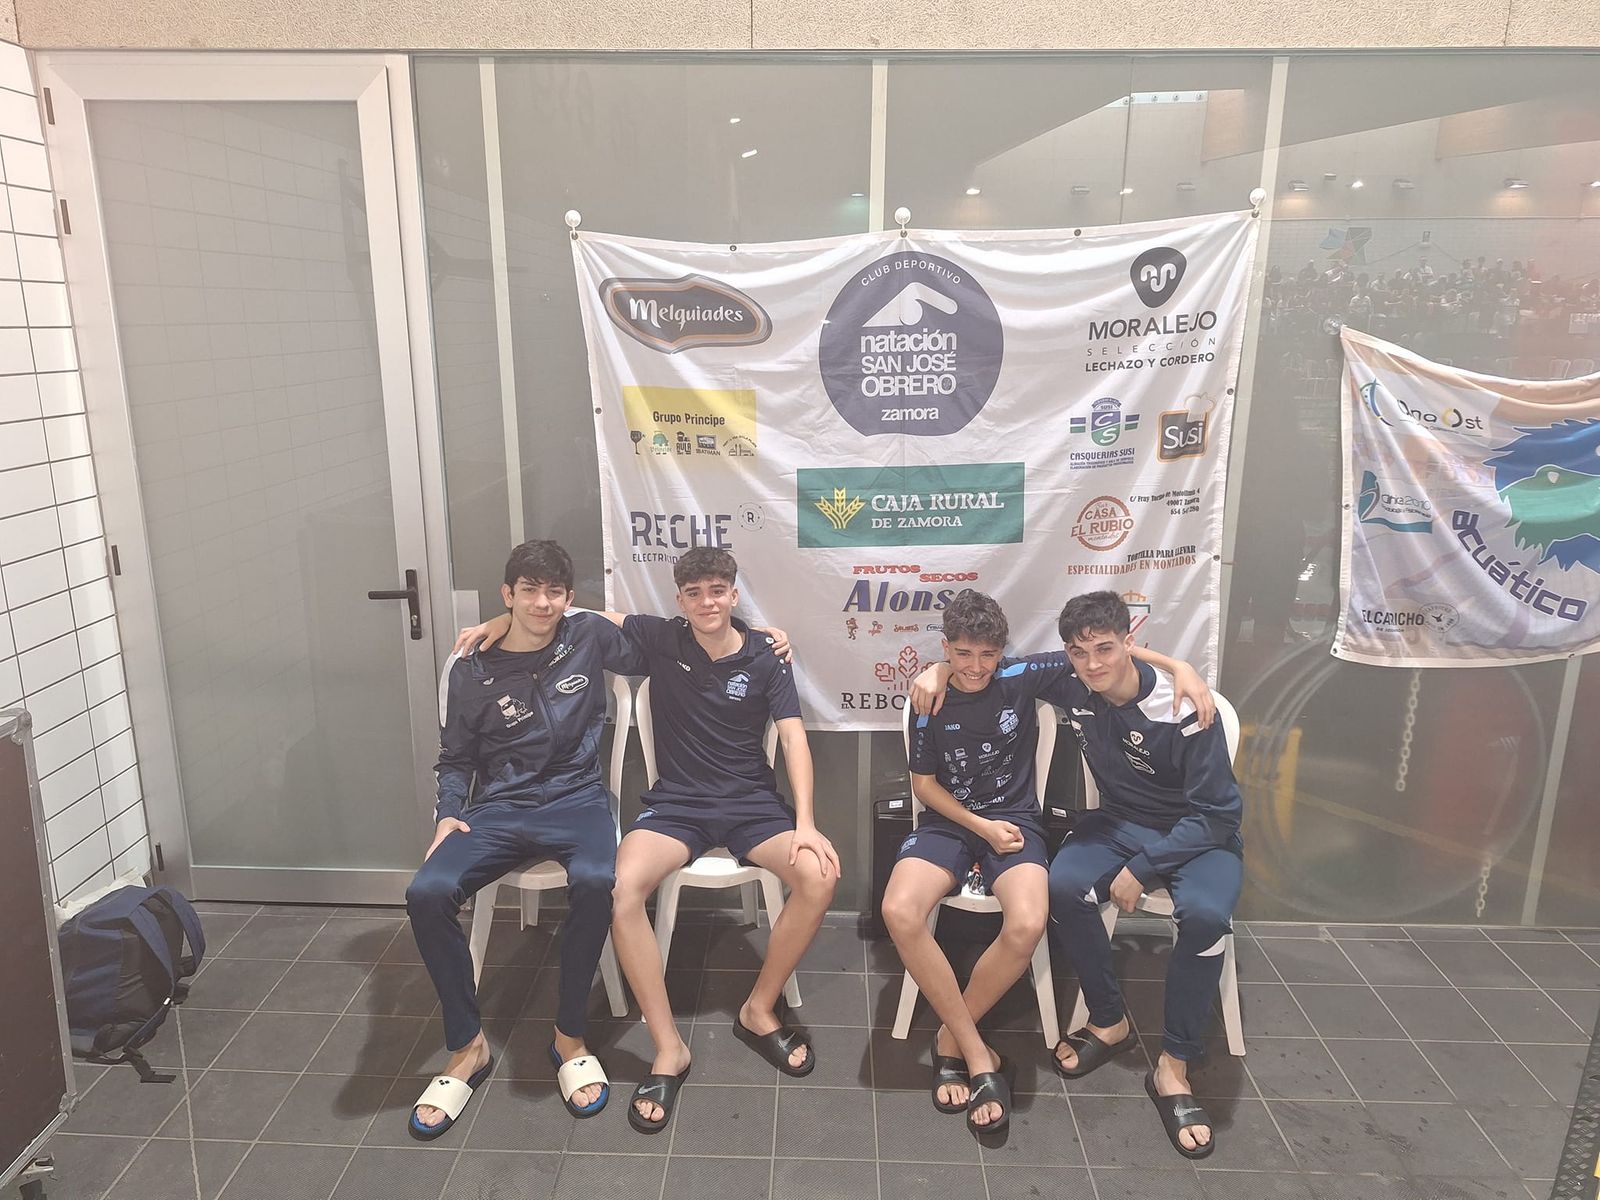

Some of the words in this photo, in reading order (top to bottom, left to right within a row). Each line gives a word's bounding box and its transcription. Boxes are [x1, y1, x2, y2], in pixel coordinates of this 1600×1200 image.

[861, 264, 891, 286] CLUB
[895, 259, 961, 284] DEPORTIVO
[629, 297, 744, 331] Melquiades
[1088, 310, 1217, 341] MORALEJO
[861, 328, 957, 353] natación
[861, 355, 901, 375] SAN
[906, 351, 957, 373] JOSÉ
[1085, 359, 1143, 372] LECHAZO
[1148, 358, 1156, 368] Y
[1160, 352, 1215, 367] CORDERO
[861, 374, 957, 397] OBRERO
[653, 411, 681, 424] Grupo
[881, 407, 939, 421] zamora
[1163, 423, 1203, 449] Susi
[1119, 448, 1135, 457] SUSI
[871, 495, 925, 512] CAJA
[929, 491, 1004, 511] RURAL
[871, 518, 892, 529] DE
[898, 516, 963, 528] ZAMORA
[1085, 507, 1116, 520] CASA
[630, 511, 732, 549] RECHE
[1071, 525, 1086, 537] EL
[1090, 518, 1134, 533] RUBIO
[1156, 549, 1174, 559] PARA
[853, 565, 921, 574] FRUTOS
[1068, 563, 1137, 575] ESPECIALIDADES
[1140, 560, 1150, 570] EN
[1153, 555, 1196, 570] MONTADOS
[919, 572, 978, 582] SECOS
[841, 692, 907, 710] REBO
